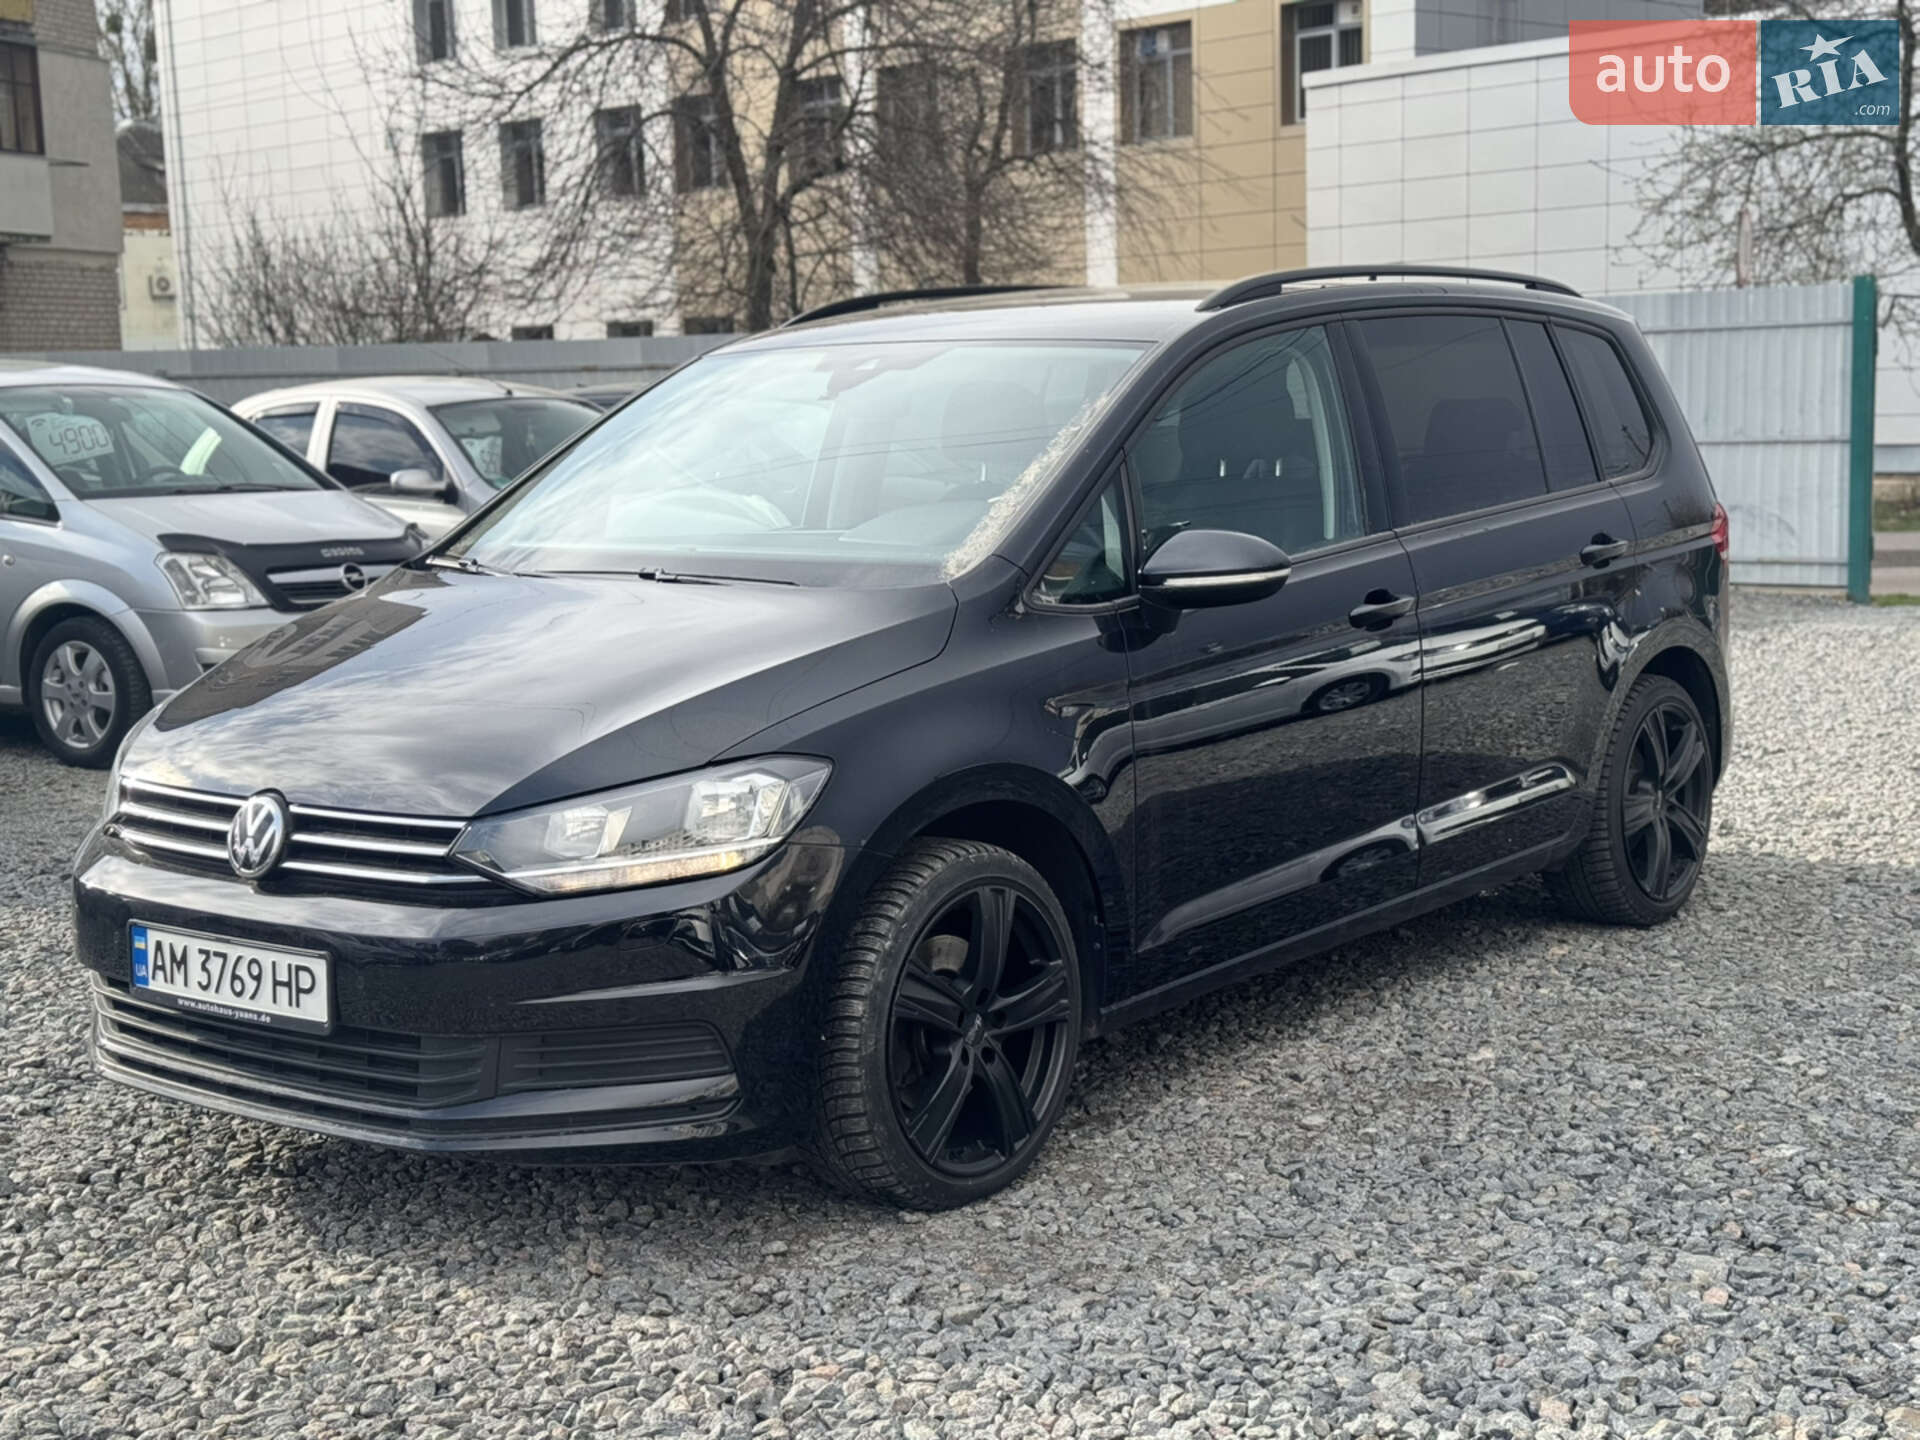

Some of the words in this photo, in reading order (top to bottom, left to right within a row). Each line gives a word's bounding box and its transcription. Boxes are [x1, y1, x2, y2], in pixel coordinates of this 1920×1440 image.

[49, 425, 109, 455] 4900
[135, 963, 148, 977] UA
[151, 940, 189, 988] AM
[197, 948, 263, 1000] 3769
[271, 960, 316, 1009] HP
